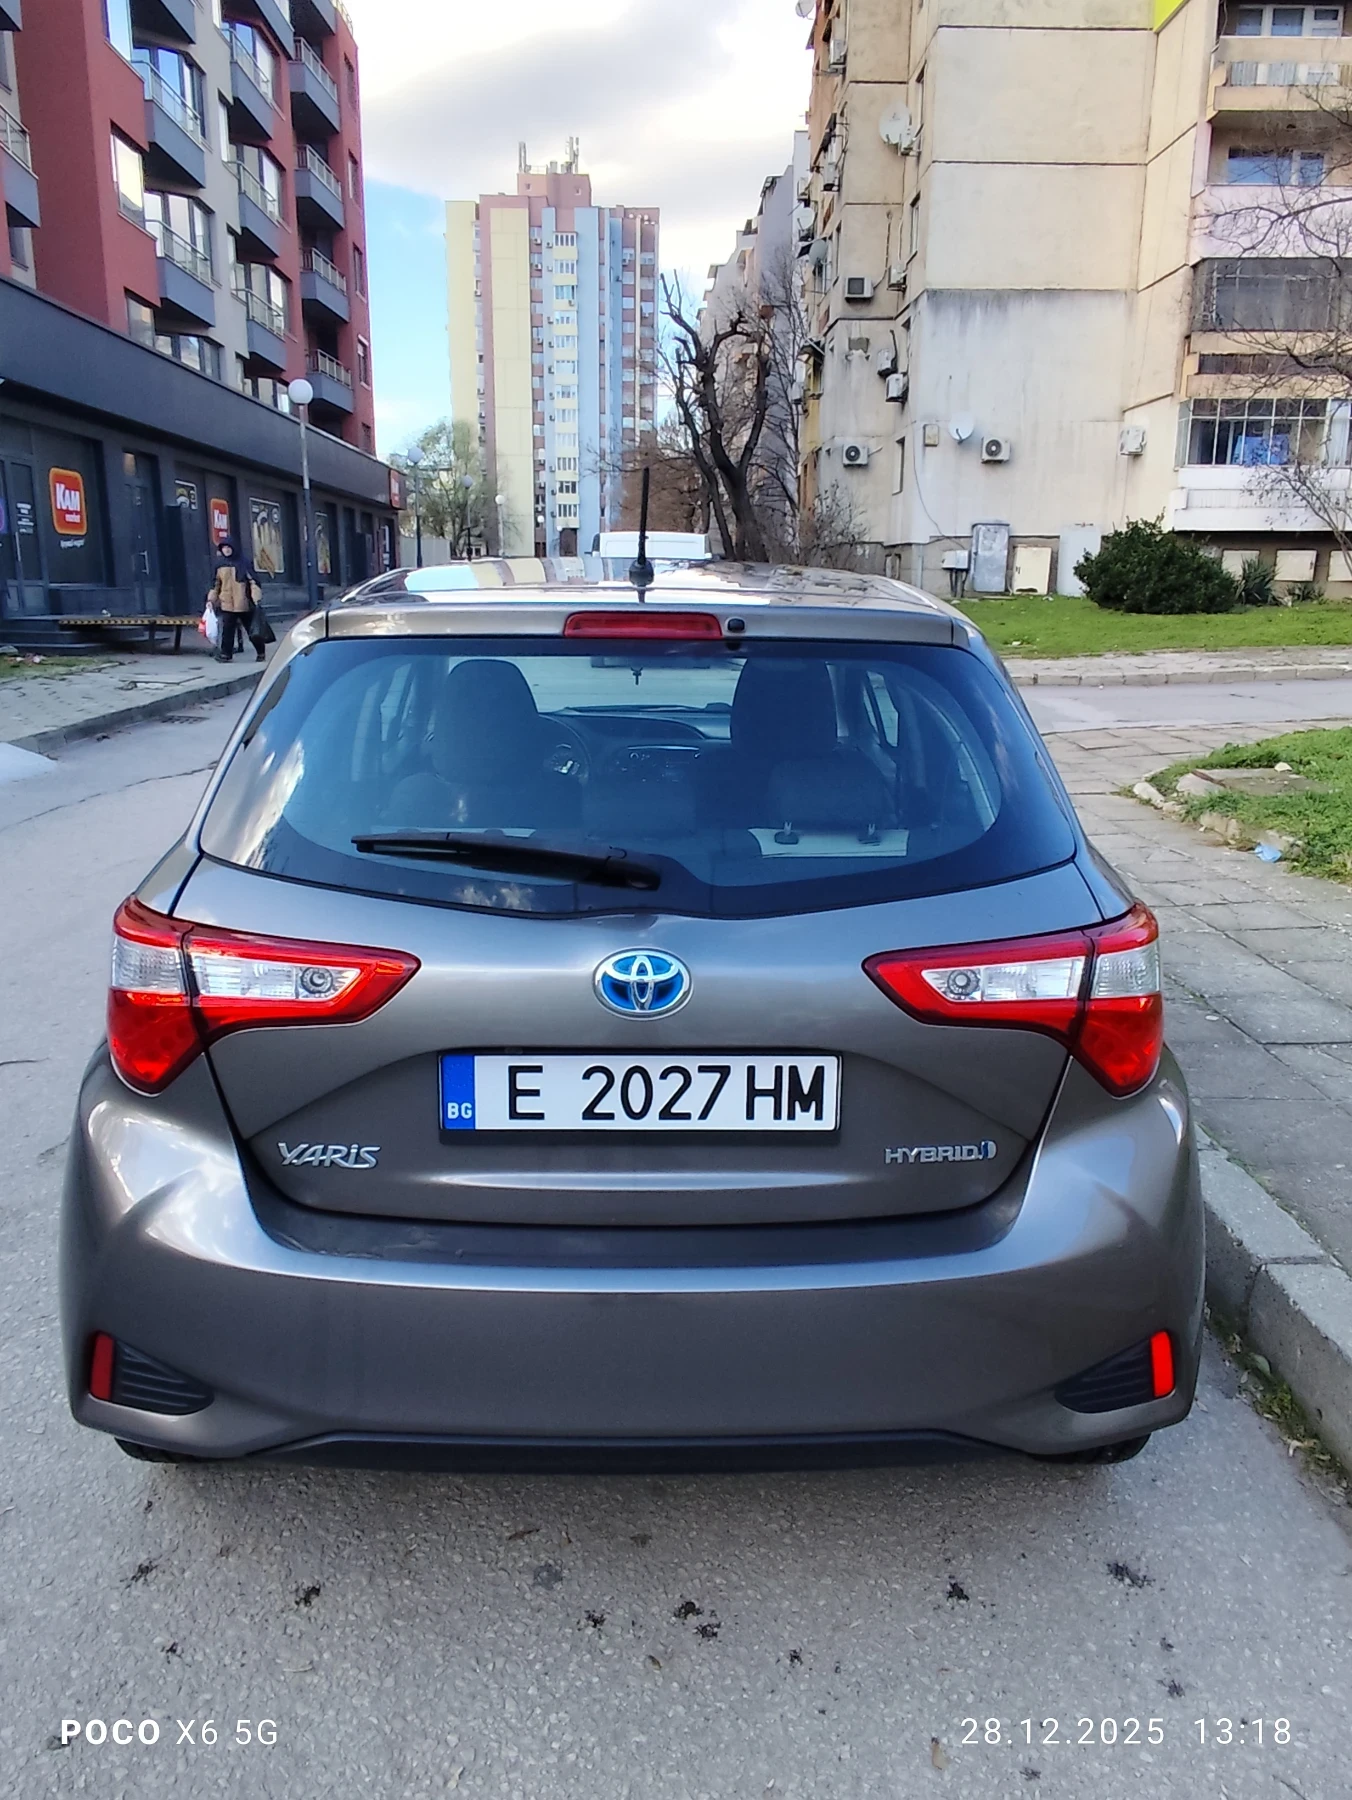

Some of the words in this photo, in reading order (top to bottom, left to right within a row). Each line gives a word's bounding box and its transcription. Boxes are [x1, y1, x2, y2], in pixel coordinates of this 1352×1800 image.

[508, 1065, 545, 1121] E
[581, 1065, 732, 1121] 2027
[745, 1065, 825, 1121] HM
[447, 1102, 473, 1120] BG
[885, 1145, 980, 1164] HYBRID
